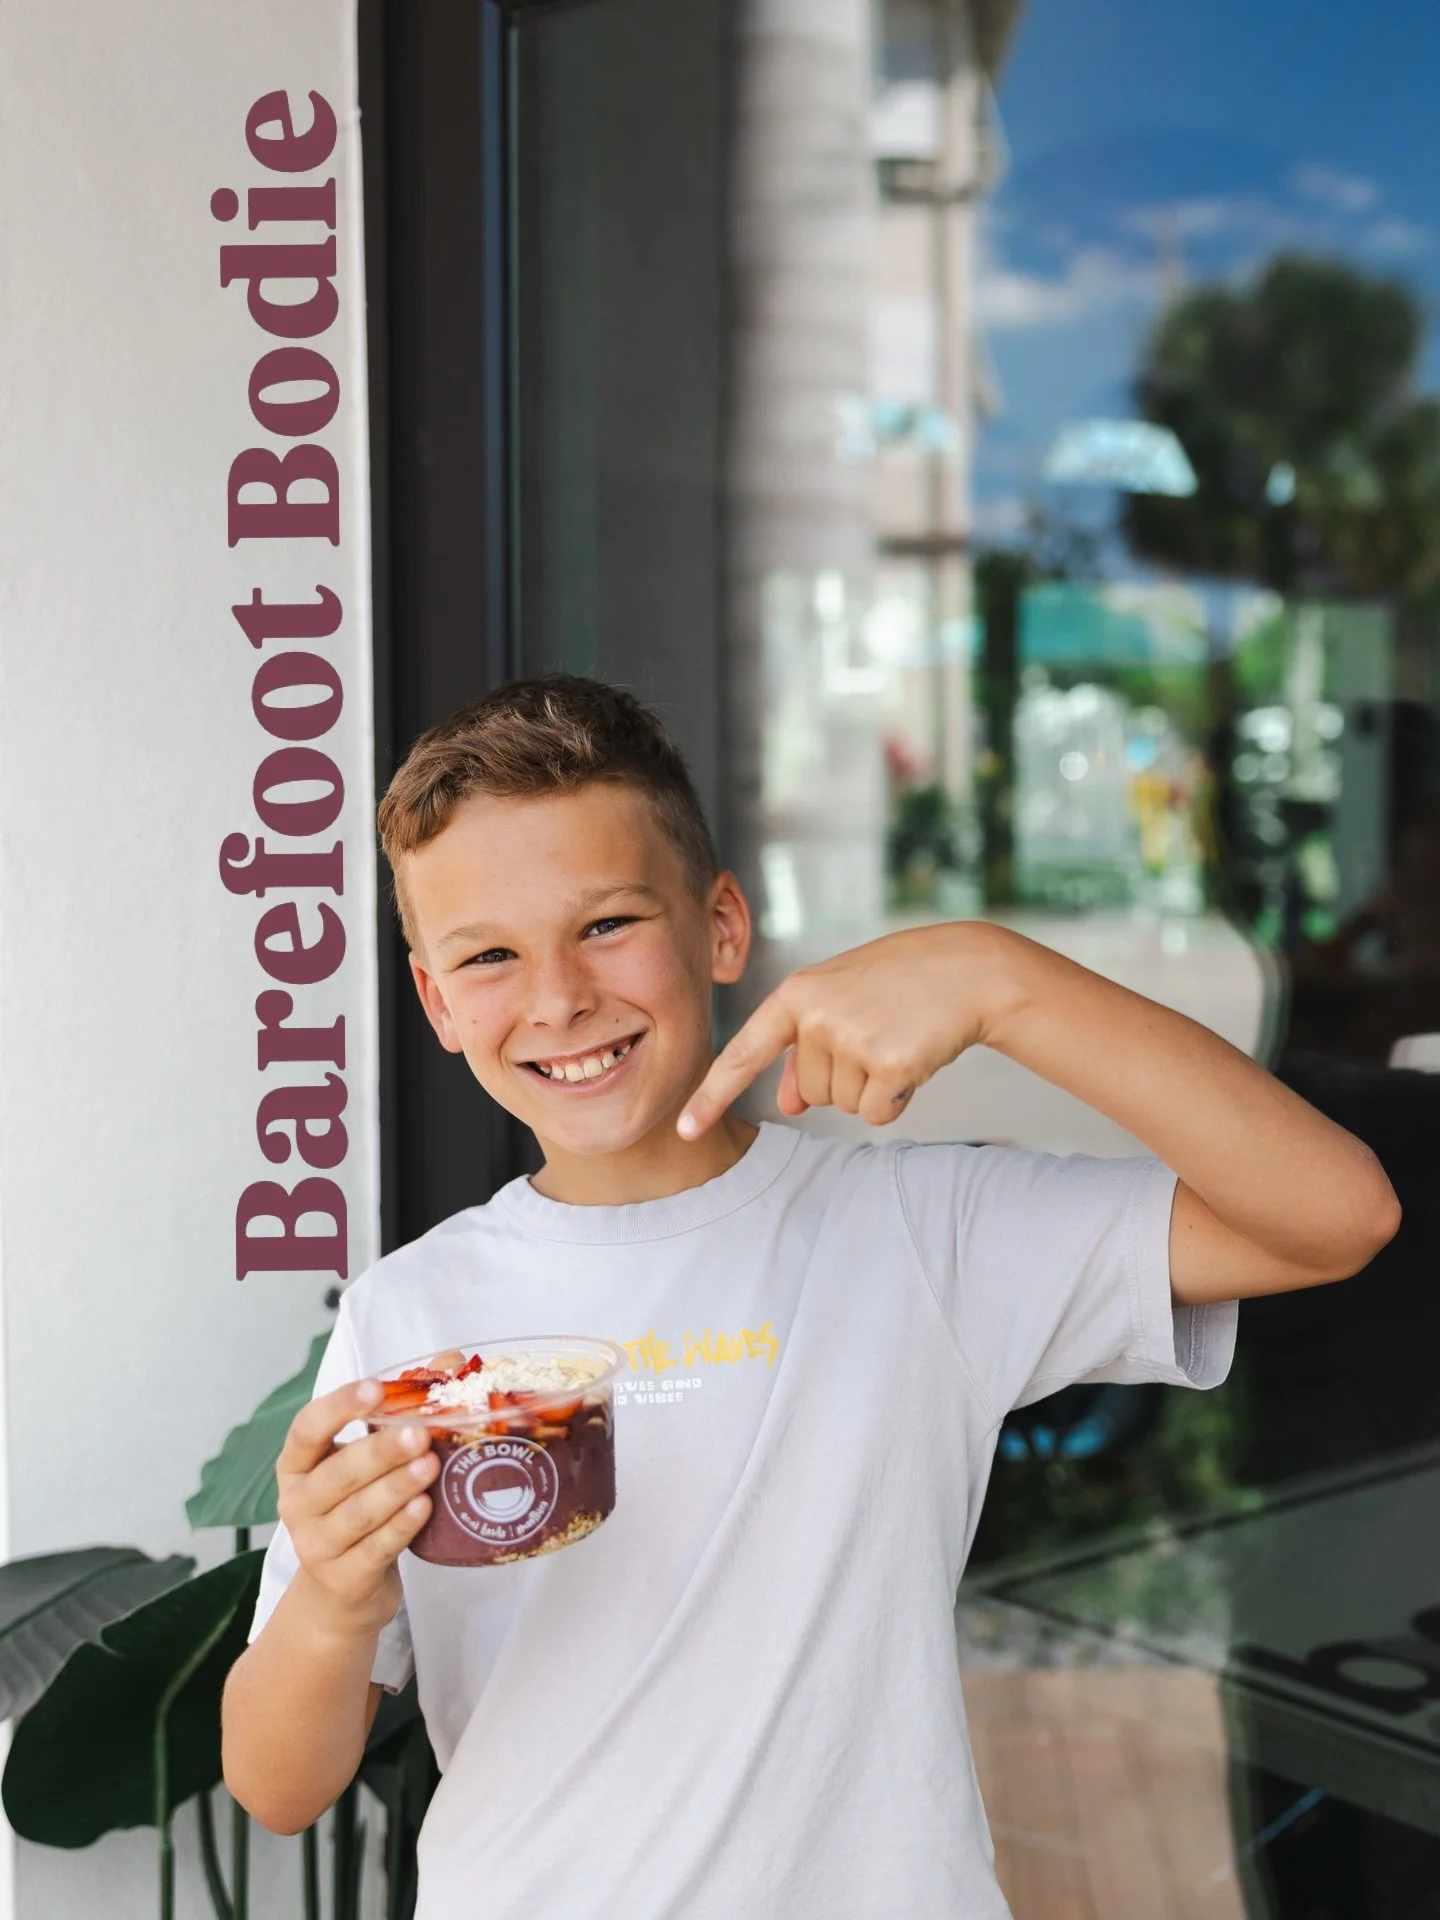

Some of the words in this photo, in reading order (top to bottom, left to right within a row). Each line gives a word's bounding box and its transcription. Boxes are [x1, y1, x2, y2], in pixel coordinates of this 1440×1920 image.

[634, 1392, 685, 1405] VIBES
[451, 1448, 483, 1476] THE
[483, 1442, 536, 1465] BOWL
